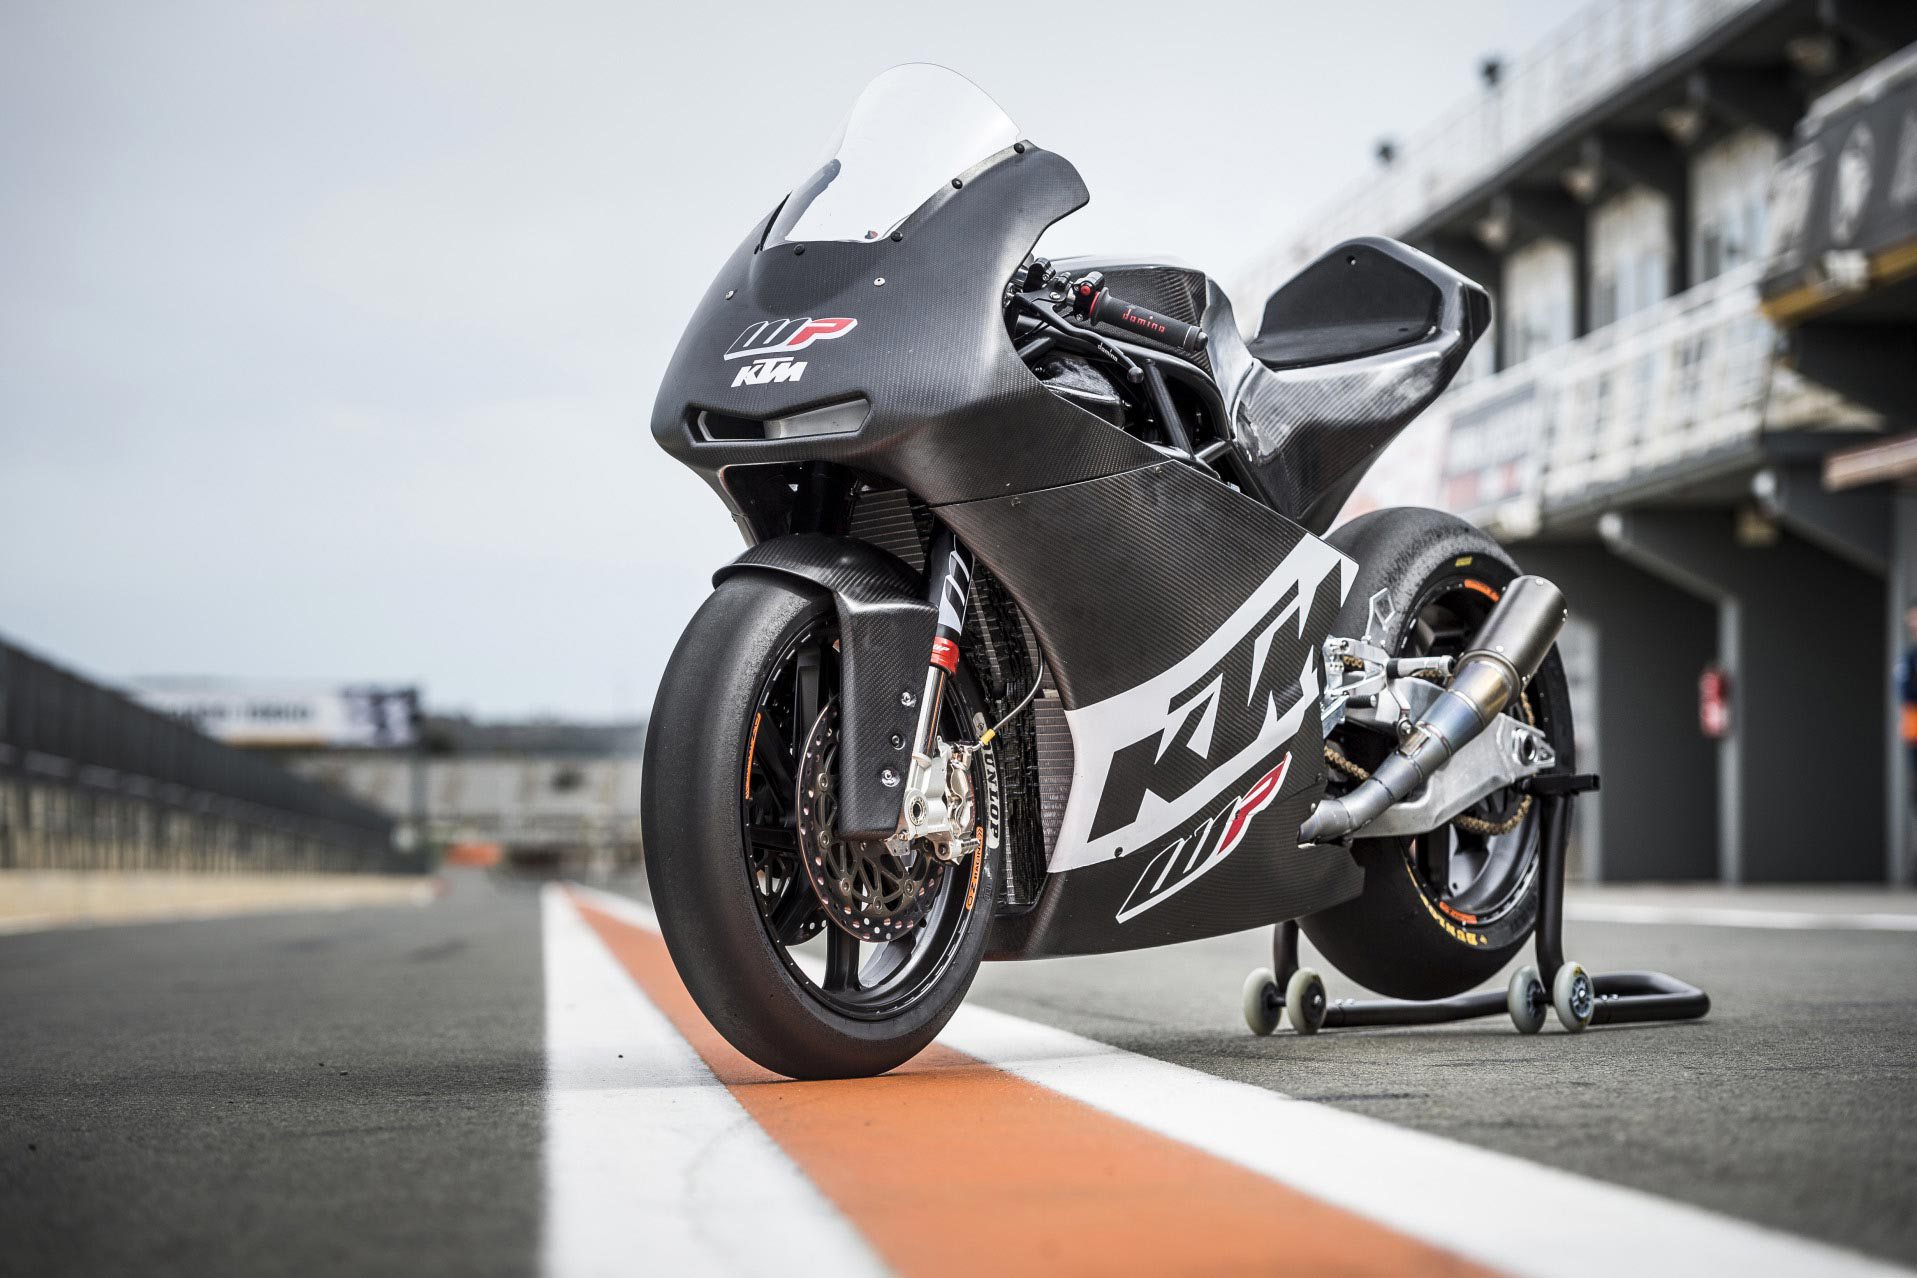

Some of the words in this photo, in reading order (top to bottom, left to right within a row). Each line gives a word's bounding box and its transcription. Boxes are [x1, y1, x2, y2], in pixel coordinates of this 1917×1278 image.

[1122, 308, 1166, 333] domino
[724, 317, 858, 360] WP
[1097, 342, 1118, 362] domino
[730, 357, 808, 388] KTM
[1086, 557, 1342, 845] KTM
